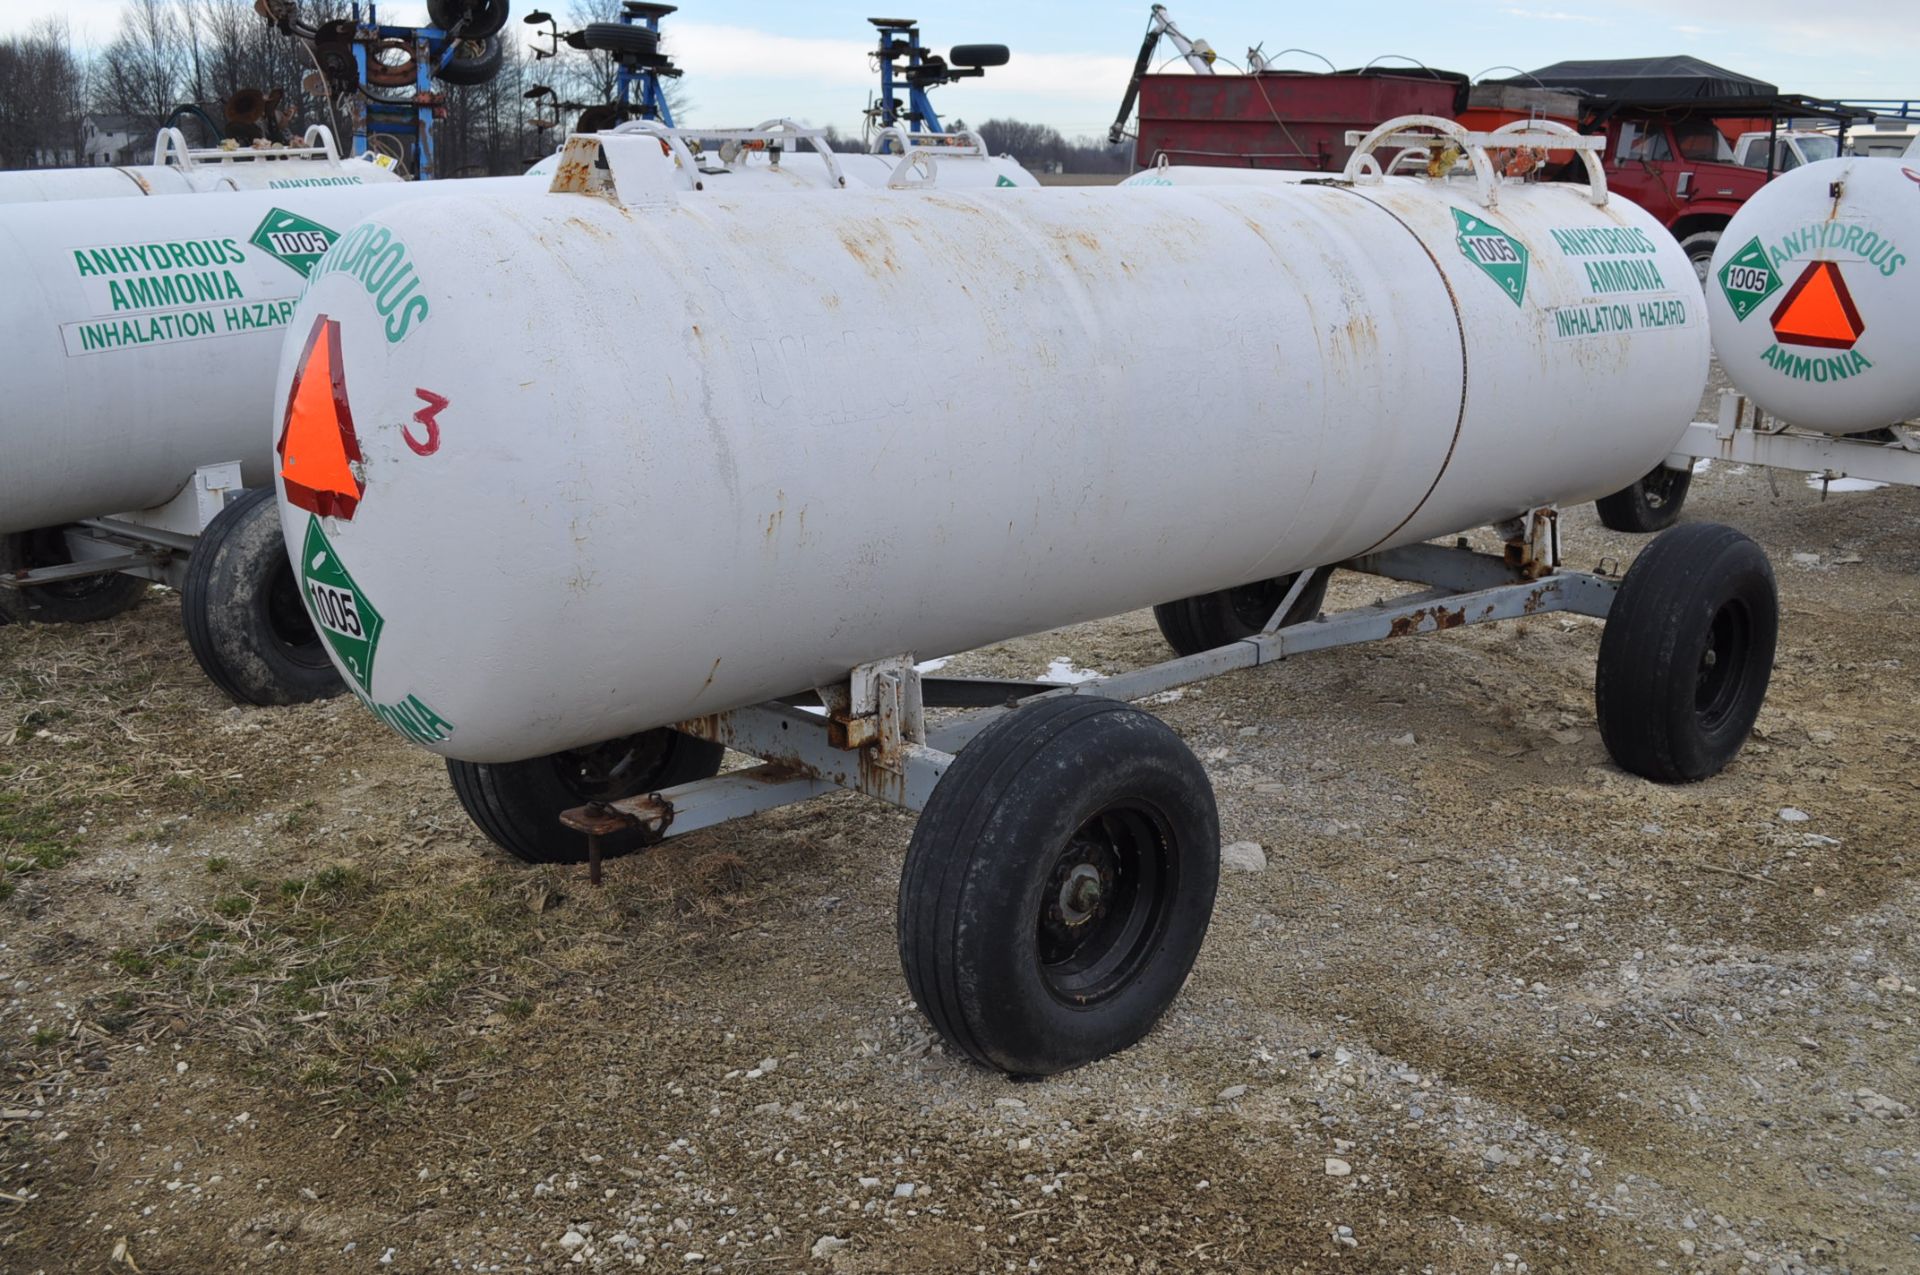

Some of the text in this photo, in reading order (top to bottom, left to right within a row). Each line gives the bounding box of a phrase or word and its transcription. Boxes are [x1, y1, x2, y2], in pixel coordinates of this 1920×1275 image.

[73, 238, 246, 277] ANHYDROUS
[271, 231, 329, 254] 1005
[1468, 237, 1518, 264] 1005
[1550, 226, 1657, 256] ANHYDROUS
[1769, 222, 1906, 277] ANHYDROUS
[108, 269, 244, 311] AMMONIA
[1506, 277, 1518, 293] 2
[1583, 259, 1666, 294] AMMONIA
[1729, 266, 1767, 292] 1005
[1555, 300, 1687, 338] INHALATION HAZARD
[1738, 301, 1746, 313] 2
[78, 300, 298, 351] INHALATION HAZAR
[1760, 344, 1873, 383] AMMONIA
[402, 387, 451, 457] 3
[311, 582, 362, 637] 1005
[348, 655, 364, 679] 2
